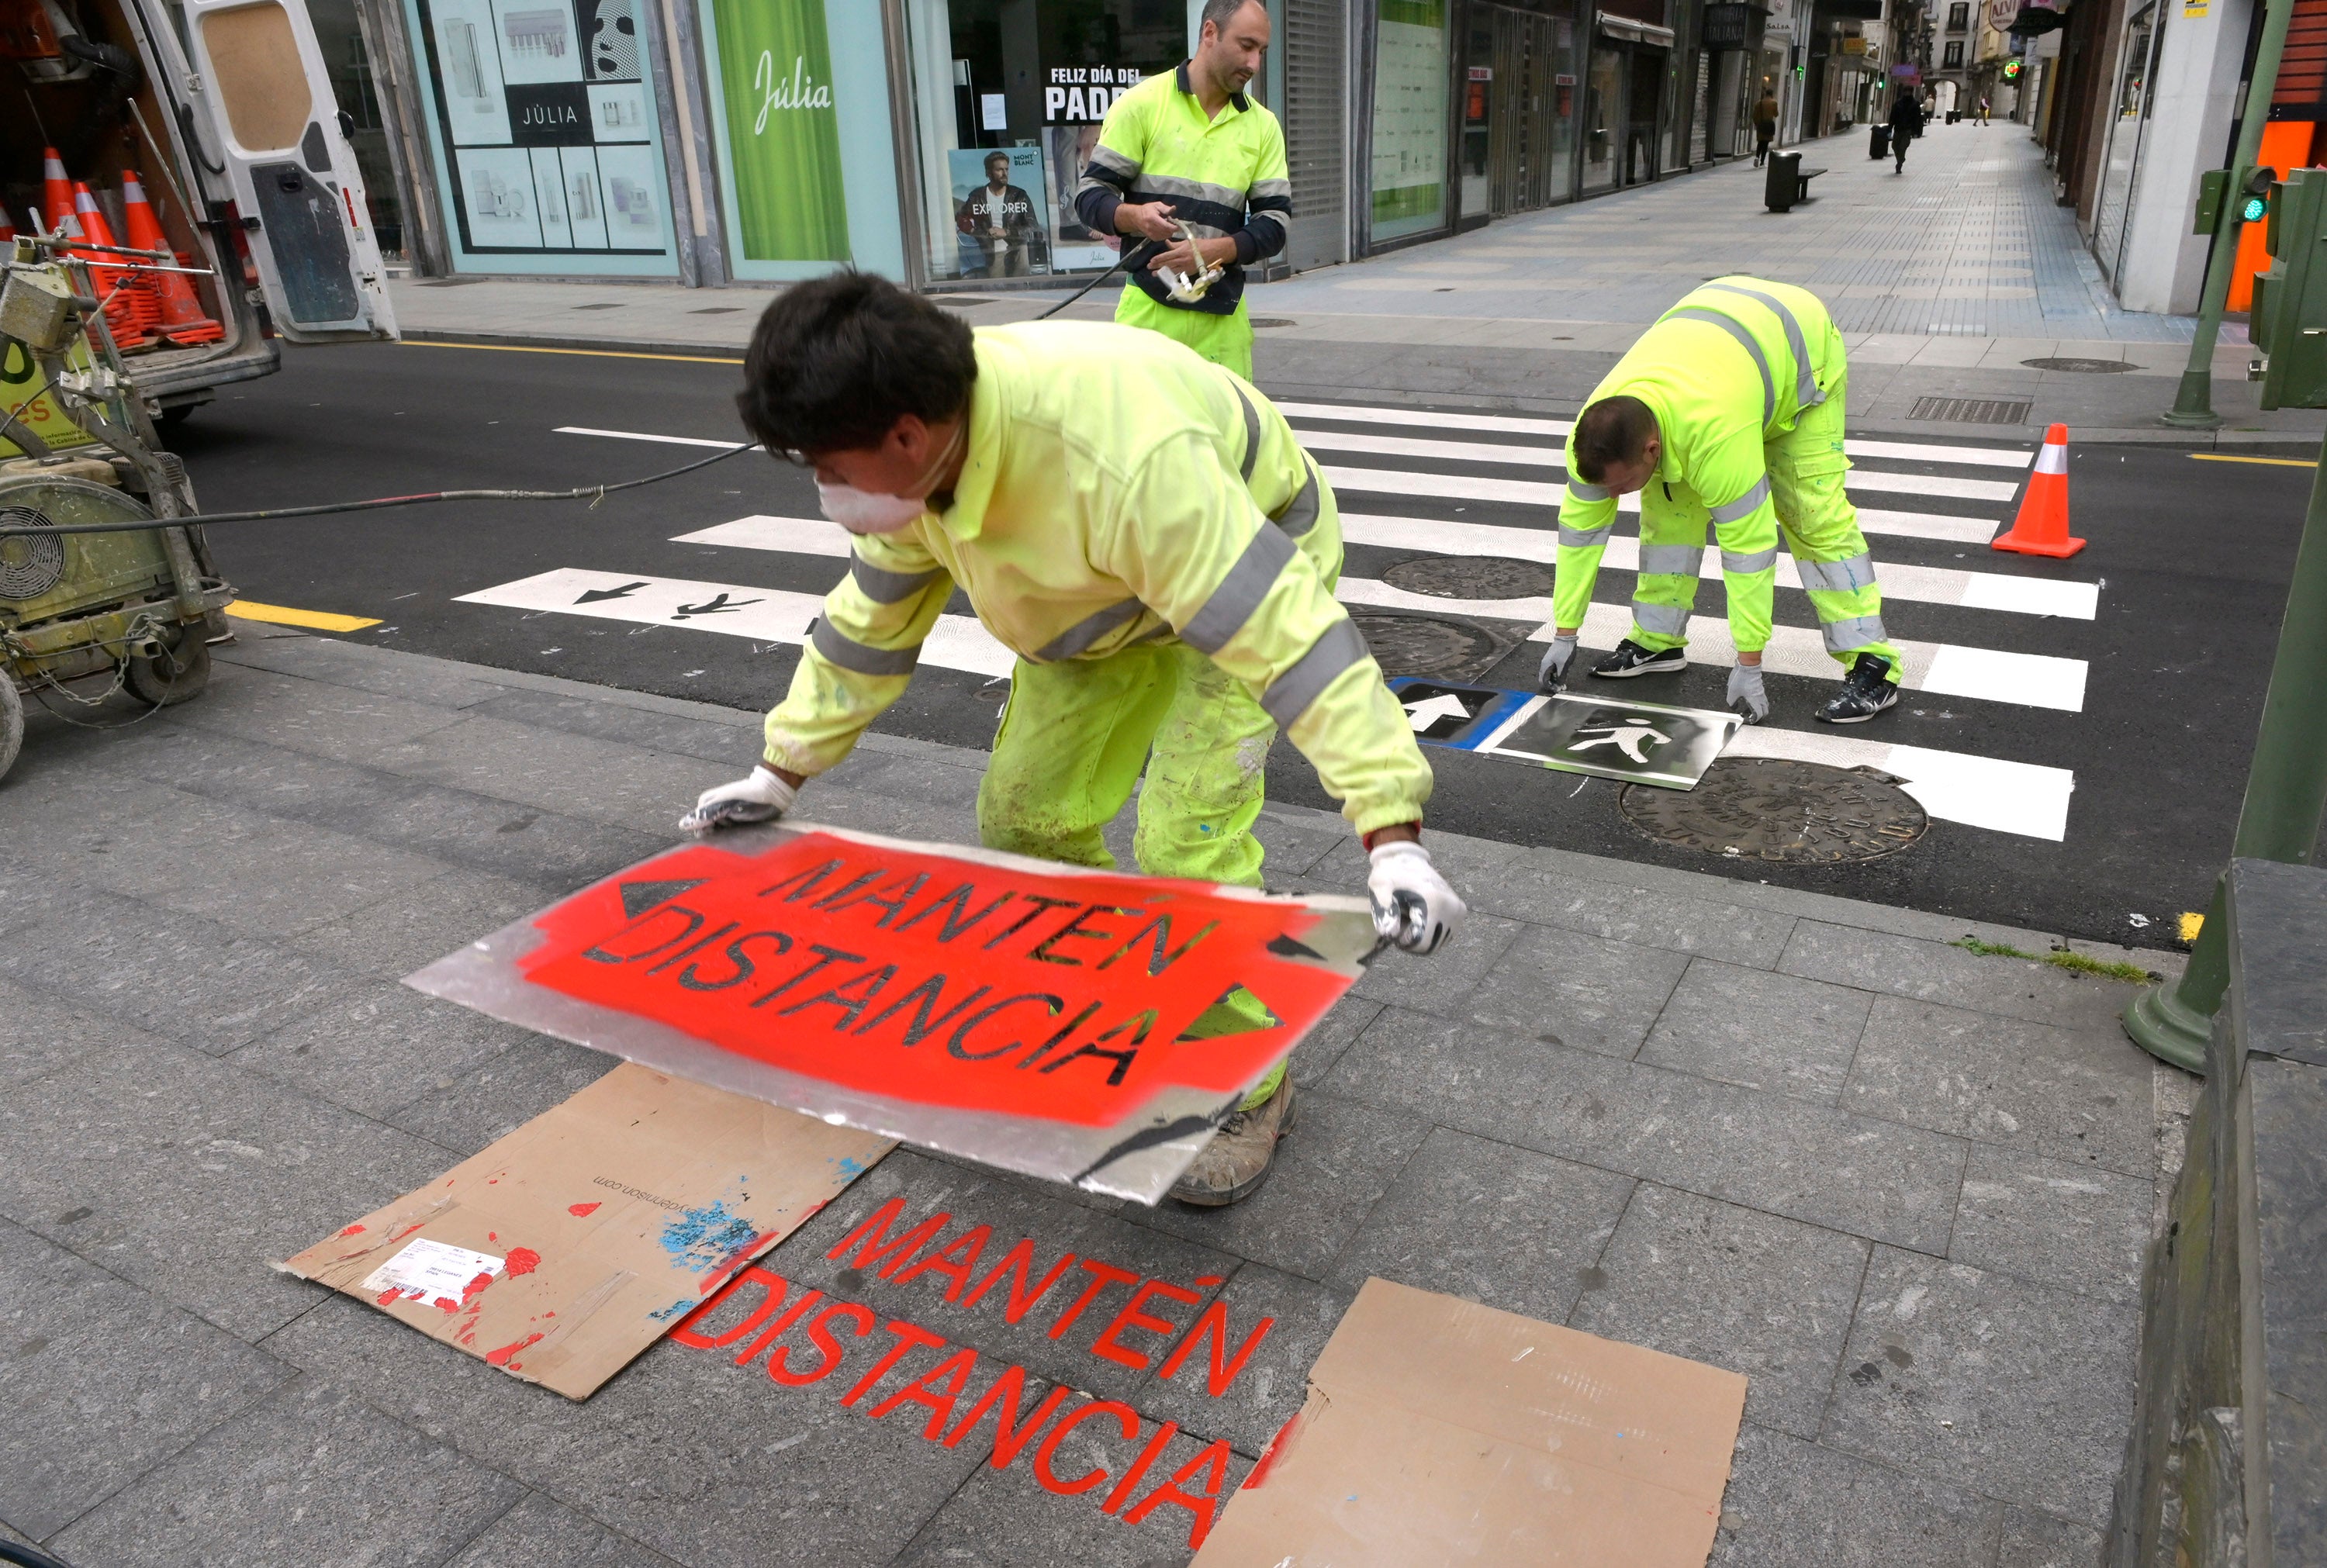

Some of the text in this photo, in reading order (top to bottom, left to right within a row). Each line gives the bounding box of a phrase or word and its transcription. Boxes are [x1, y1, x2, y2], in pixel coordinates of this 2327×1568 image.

[755, 50, 832, 135] Júlia
[1051, 64, 1143, 83] FELIZ DÍA DEL
[523, 103, 578, 125] JÚLIA
[1045, 87, 1129, 120] PAD
[973, 202, 1028, 215] EXPLORER
[583, 906, 1158, 1086] DISTANCIA
[826, 1198, 1274, 1396] MANTÉN
[671, 1267, 1231, 1550] DISTANCIA
